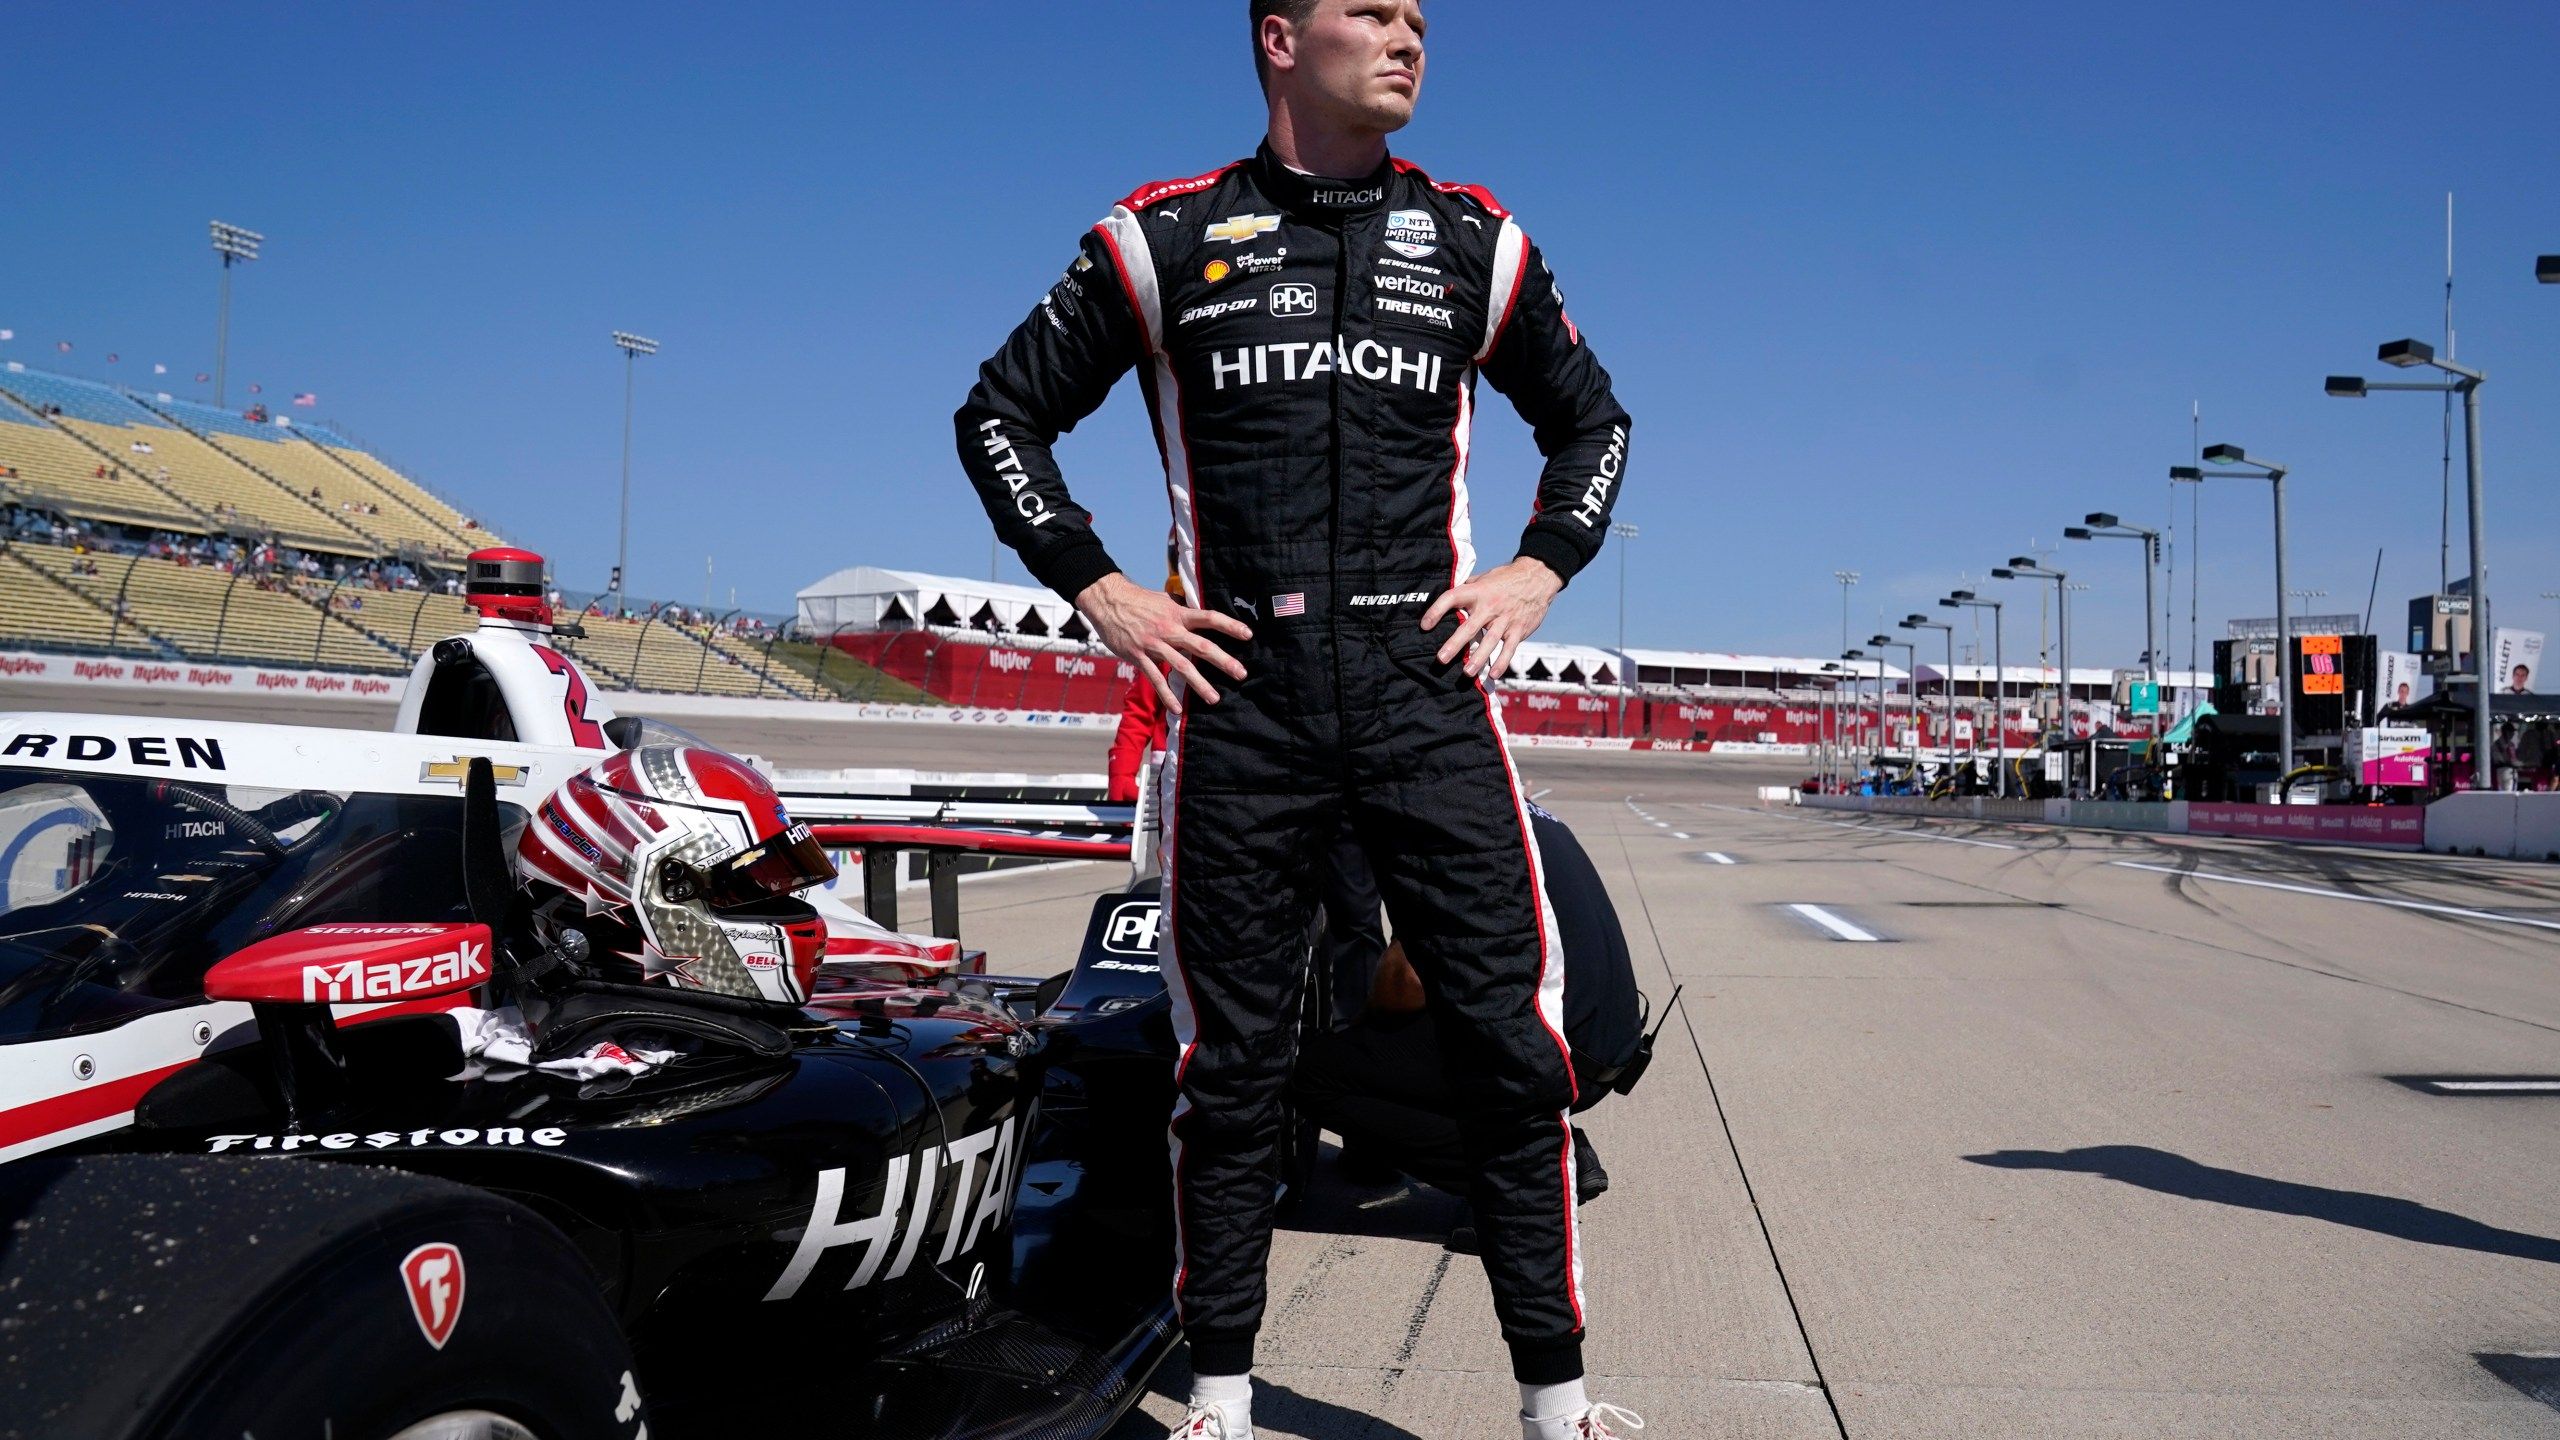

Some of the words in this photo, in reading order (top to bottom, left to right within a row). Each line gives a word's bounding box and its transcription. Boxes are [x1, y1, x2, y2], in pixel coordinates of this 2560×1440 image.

[1313, 186, 1383, 203] HITACHI
[1409, 218, 1432, 226] NTT
[1385, 229, 1437, 240] INDYCAR
[1395, 236, 1425, 244] SERIES
[1236, 253, 1254, 262] Shell
[1237, 256, 1283, 268] V-Power
[1378, 258, 1441, 275] NEWGARDEN
[1374, 275, 1445, 299] verizon
[1273, 287, 1313, 312] PPG
[1376, 298, 1411, 313] TIRE
[1412, 303, 1453, 329] RACK
[1427, 319, 1447, 327] .com
[1212, 334, 1442, 393] HITACHI
[980, 419, 1057, 526] HITACI
[1572, 425, 1626, 528] HITACHI
[529, 643, 606, 750] 2
[2, 734, 226, 770] RDEN
[165, 821, 225, 839] HITACHI
[123, 892, 187, 901] HITACHI
[747, 956, 778, 966] BELL
[303, 940, 486, 1003] Mazak
[205, 1127, 568, 1153] Firestone
